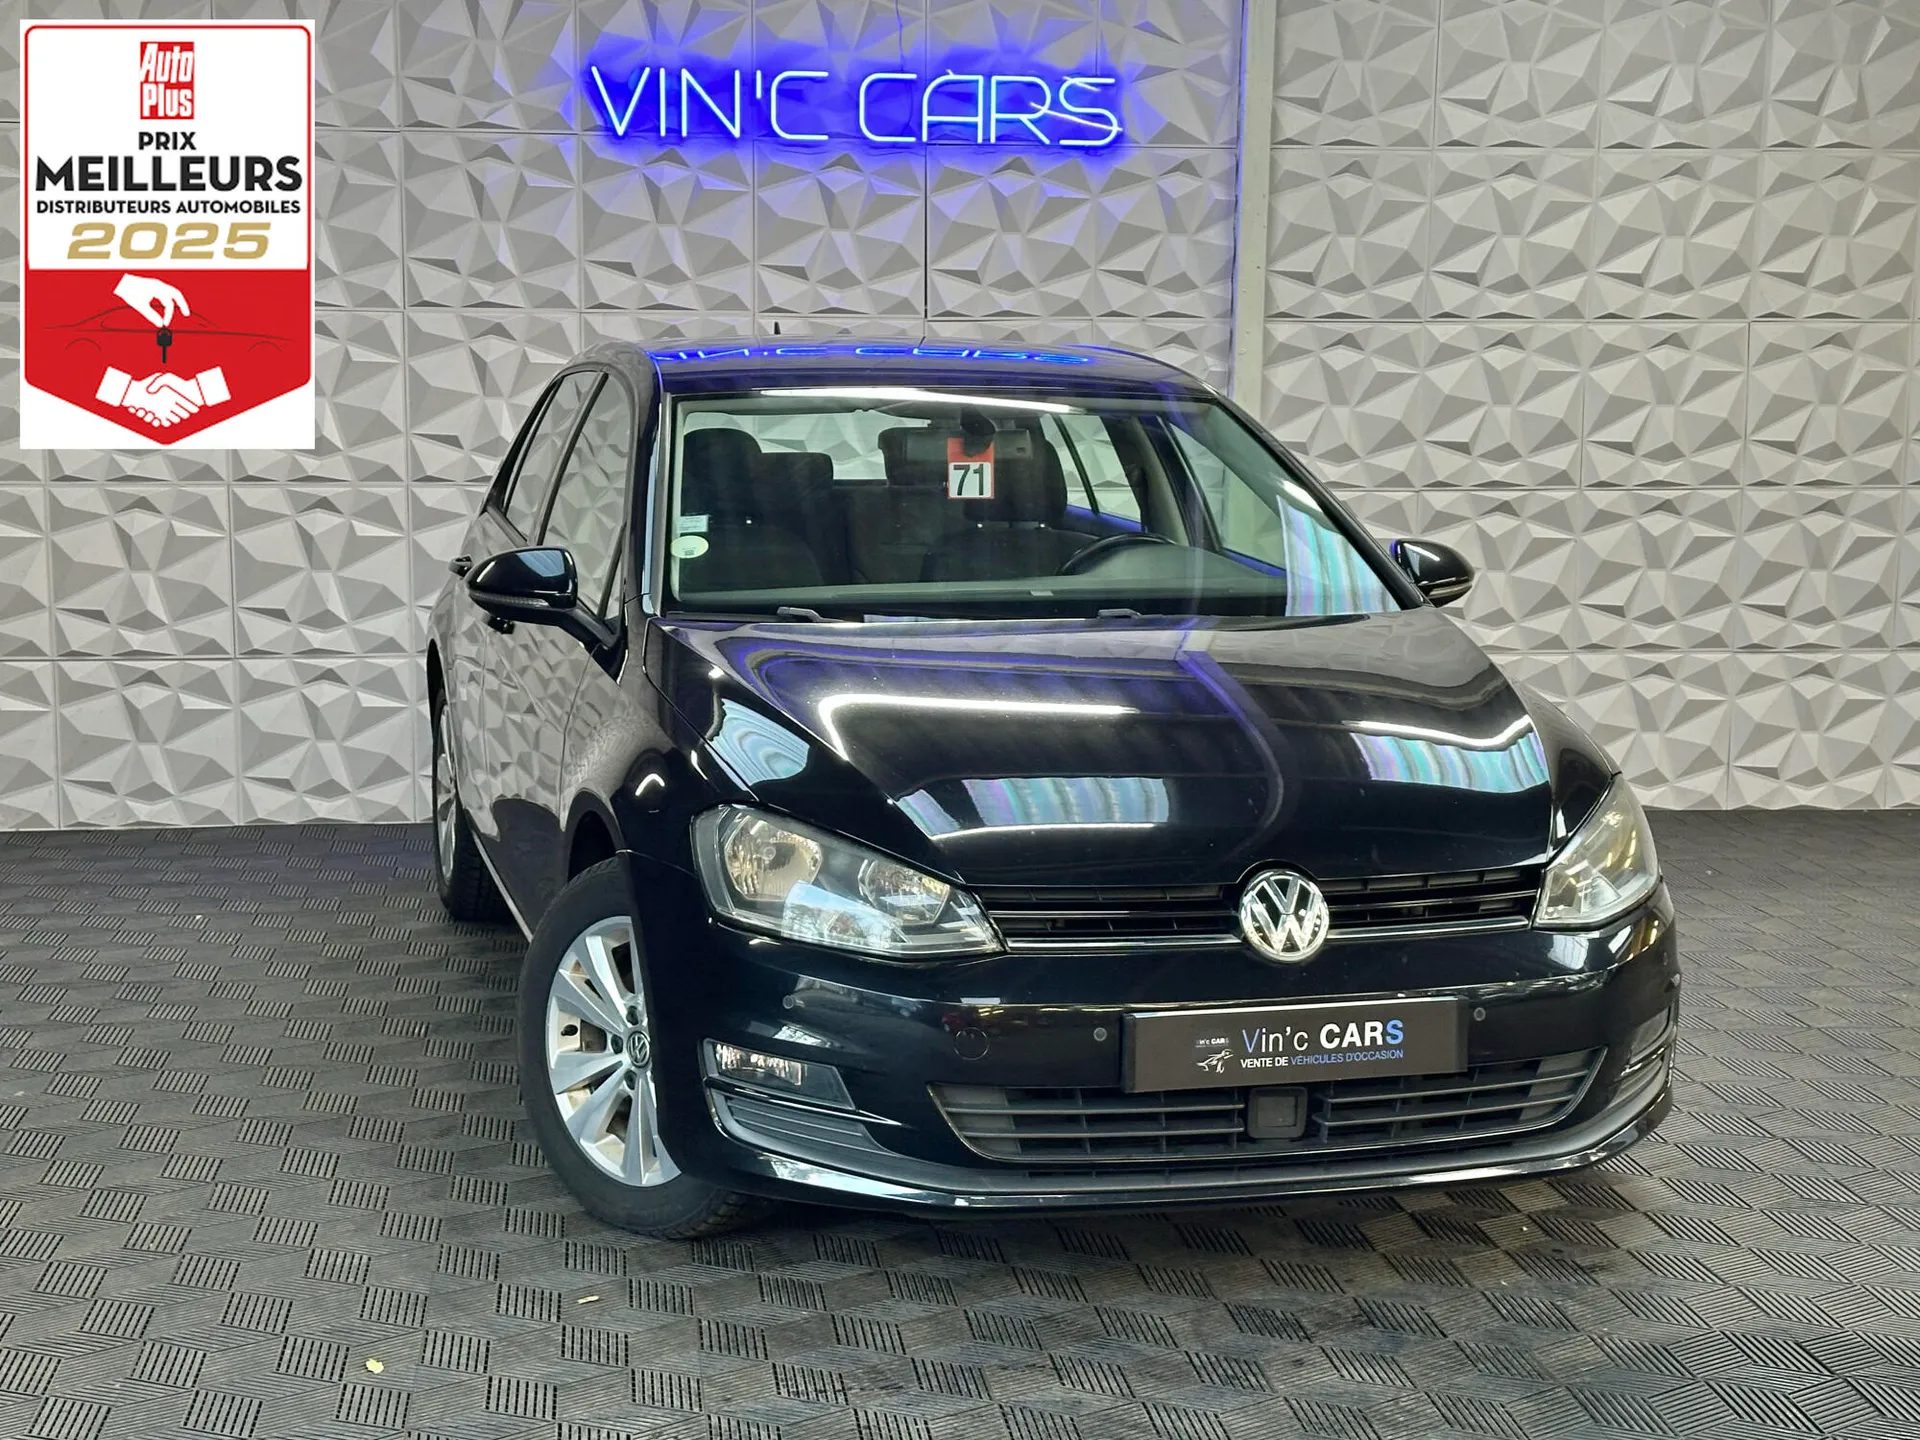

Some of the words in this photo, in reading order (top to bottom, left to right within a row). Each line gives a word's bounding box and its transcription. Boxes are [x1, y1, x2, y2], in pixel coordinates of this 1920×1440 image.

[591, 65, 829, 141] VIN'C
[858, 69, 1122, 145] CARS
[953, 464, 984, 496] 71
[1319, 1019, 1404, 1050] CARS
[1240, 1057, 1273, 1069] VENTE
[1274, 1056, 1289, 1067] DE
[1345, 1049, 1404, 1062] D'OCCASION
